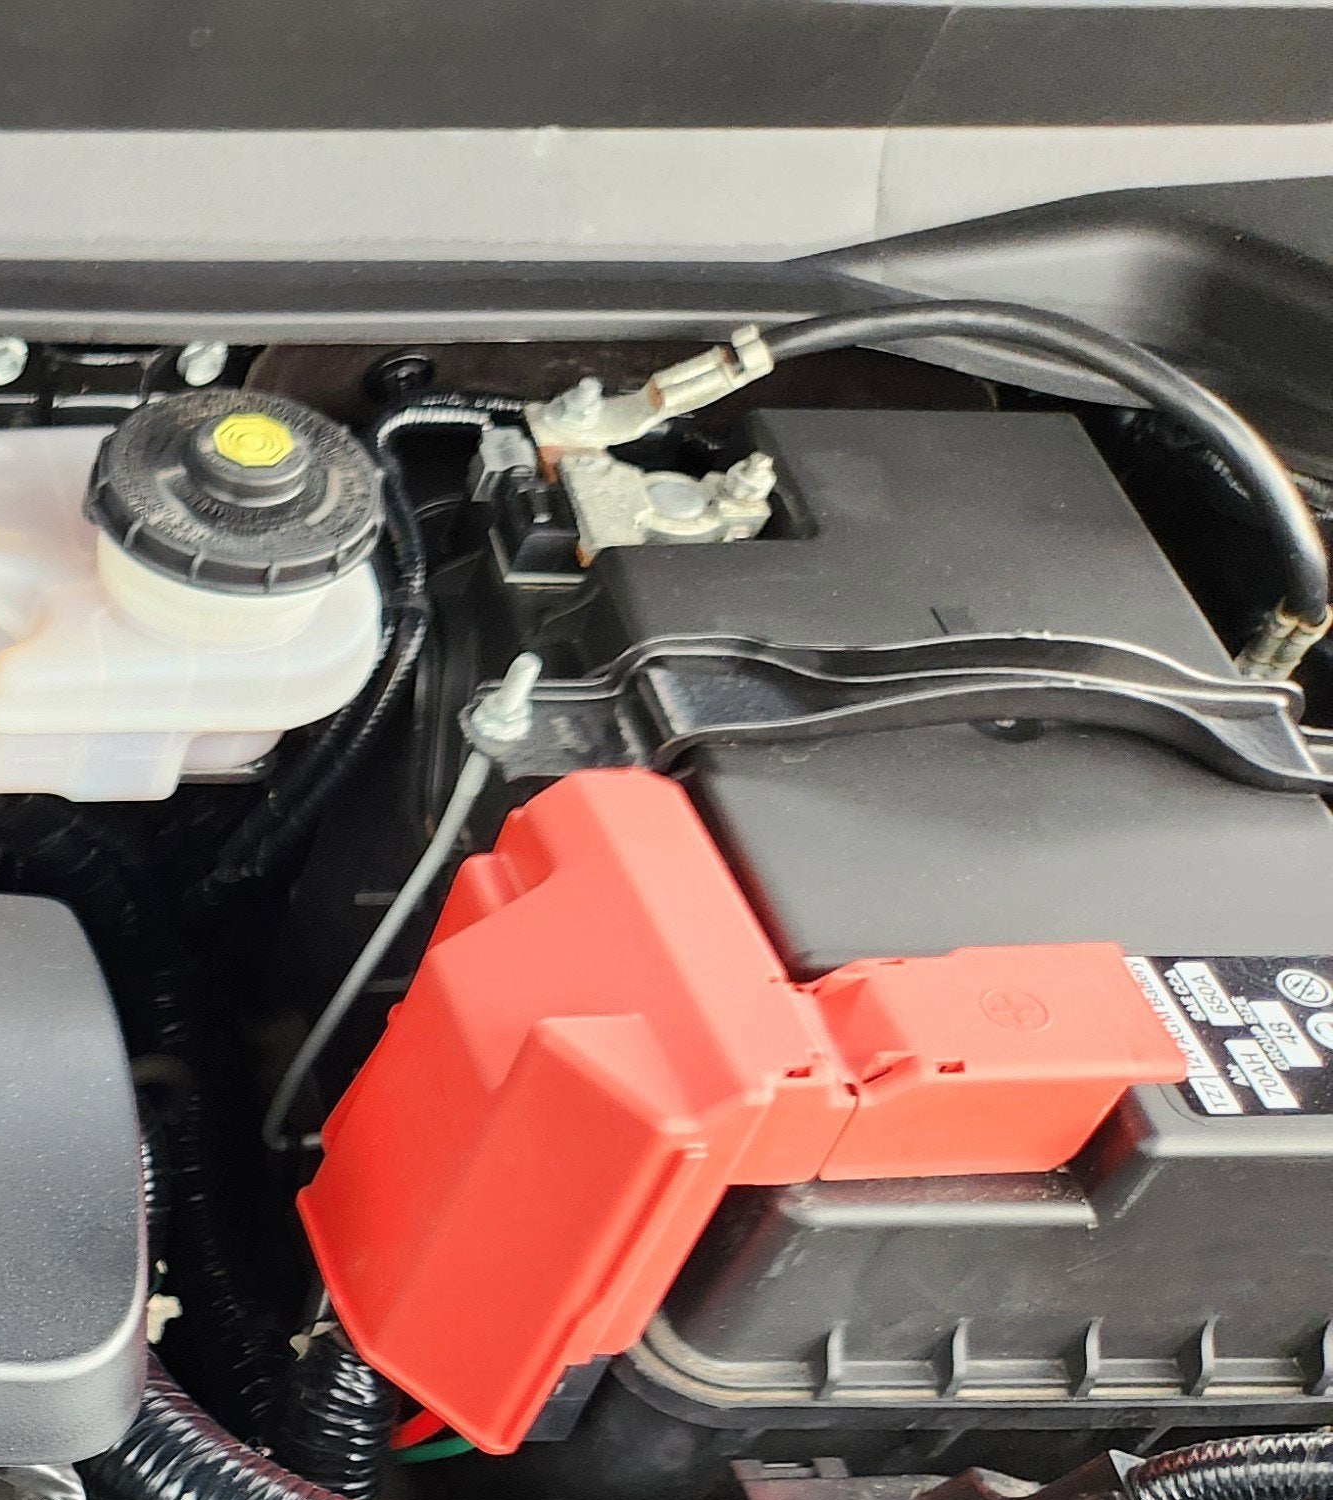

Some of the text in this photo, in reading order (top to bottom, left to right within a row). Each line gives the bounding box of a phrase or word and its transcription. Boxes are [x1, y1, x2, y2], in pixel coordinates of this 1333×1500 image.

[1180, 995, 1208, 1022] SAE
[1189, 974, 1229, 1015] 650A
[1230, 995, 1290, 1072] GROUP SIZE
[1268, 1021, 1299, 1046] 48
[1239, 1052, 1286, 1098] 70AH
